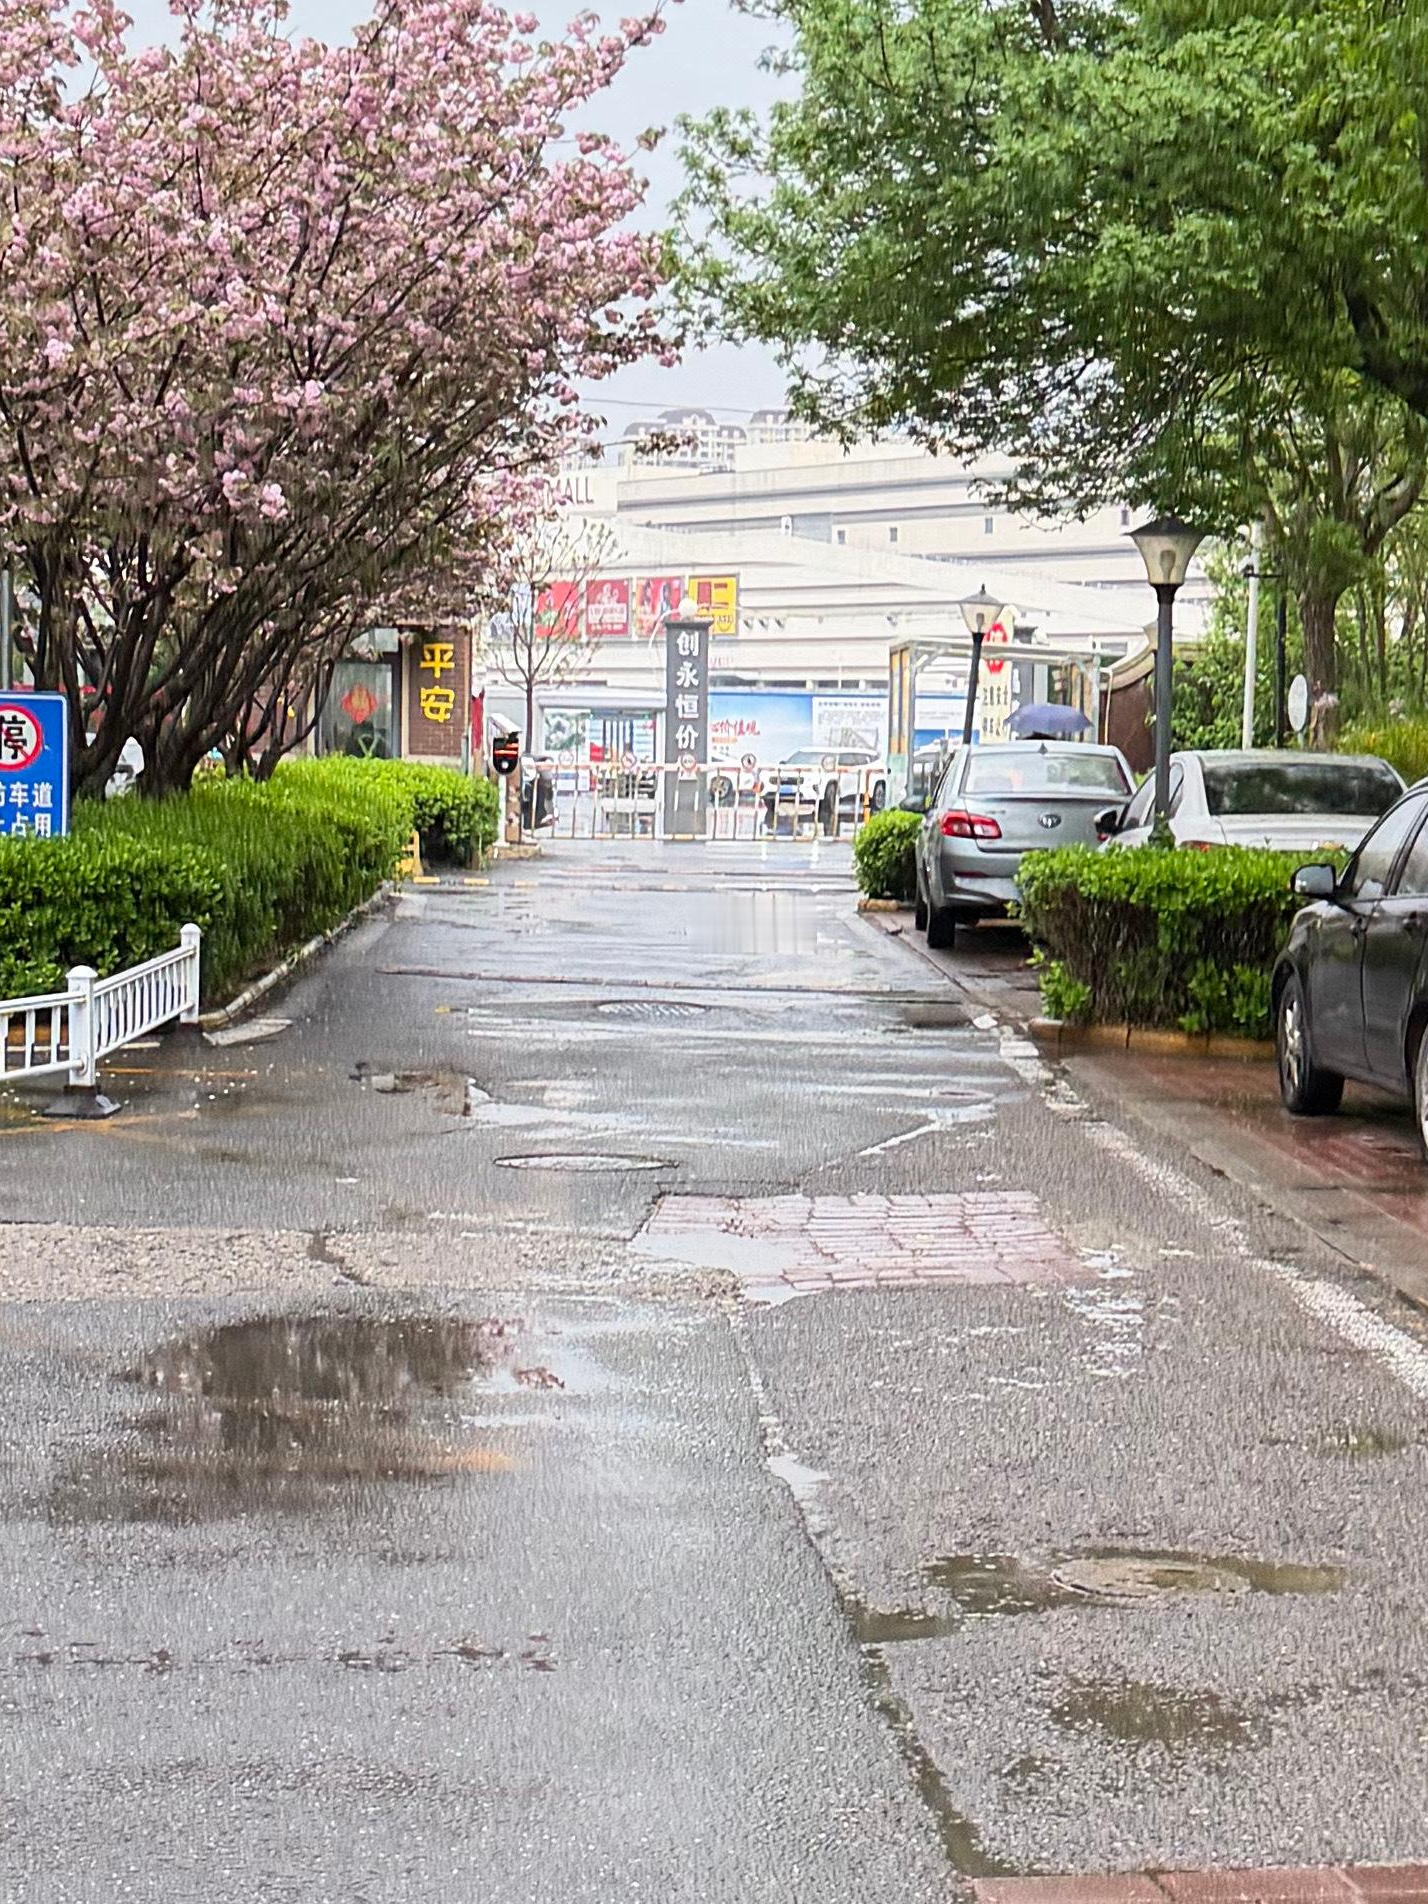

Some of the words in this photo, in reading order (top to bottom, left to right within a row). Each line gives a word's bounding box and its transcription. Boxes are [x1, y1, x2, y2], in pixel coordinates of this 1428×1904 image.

[420, 642, 455, 724] 平安
[675, 631, 700, 780] 创永恒价
